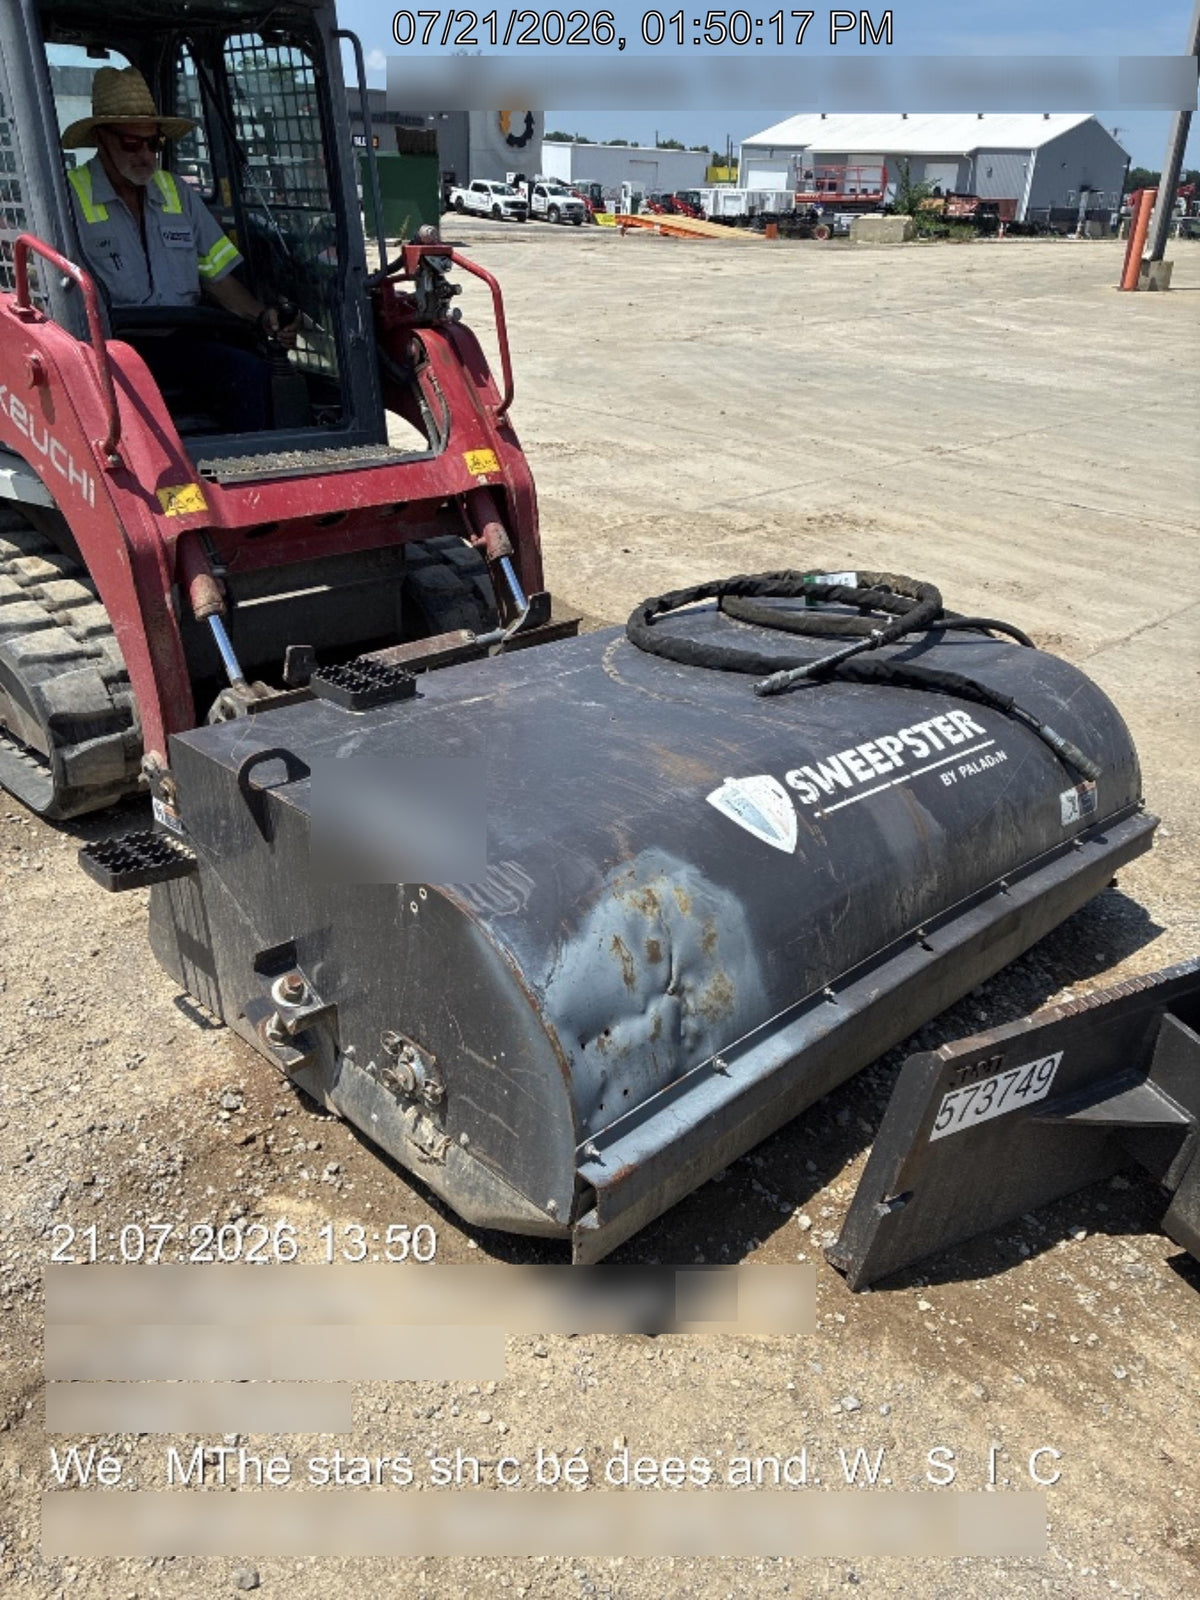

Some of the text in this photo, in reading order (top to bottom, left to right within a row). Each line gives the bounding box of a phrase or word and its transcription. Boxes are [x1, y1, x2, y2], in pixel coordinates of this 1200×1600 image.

[785, 709, 987, 804] SWEEPSTER
[940, 770, 958, 787] BY
[935, 1058, 1055, 1131] 573749
